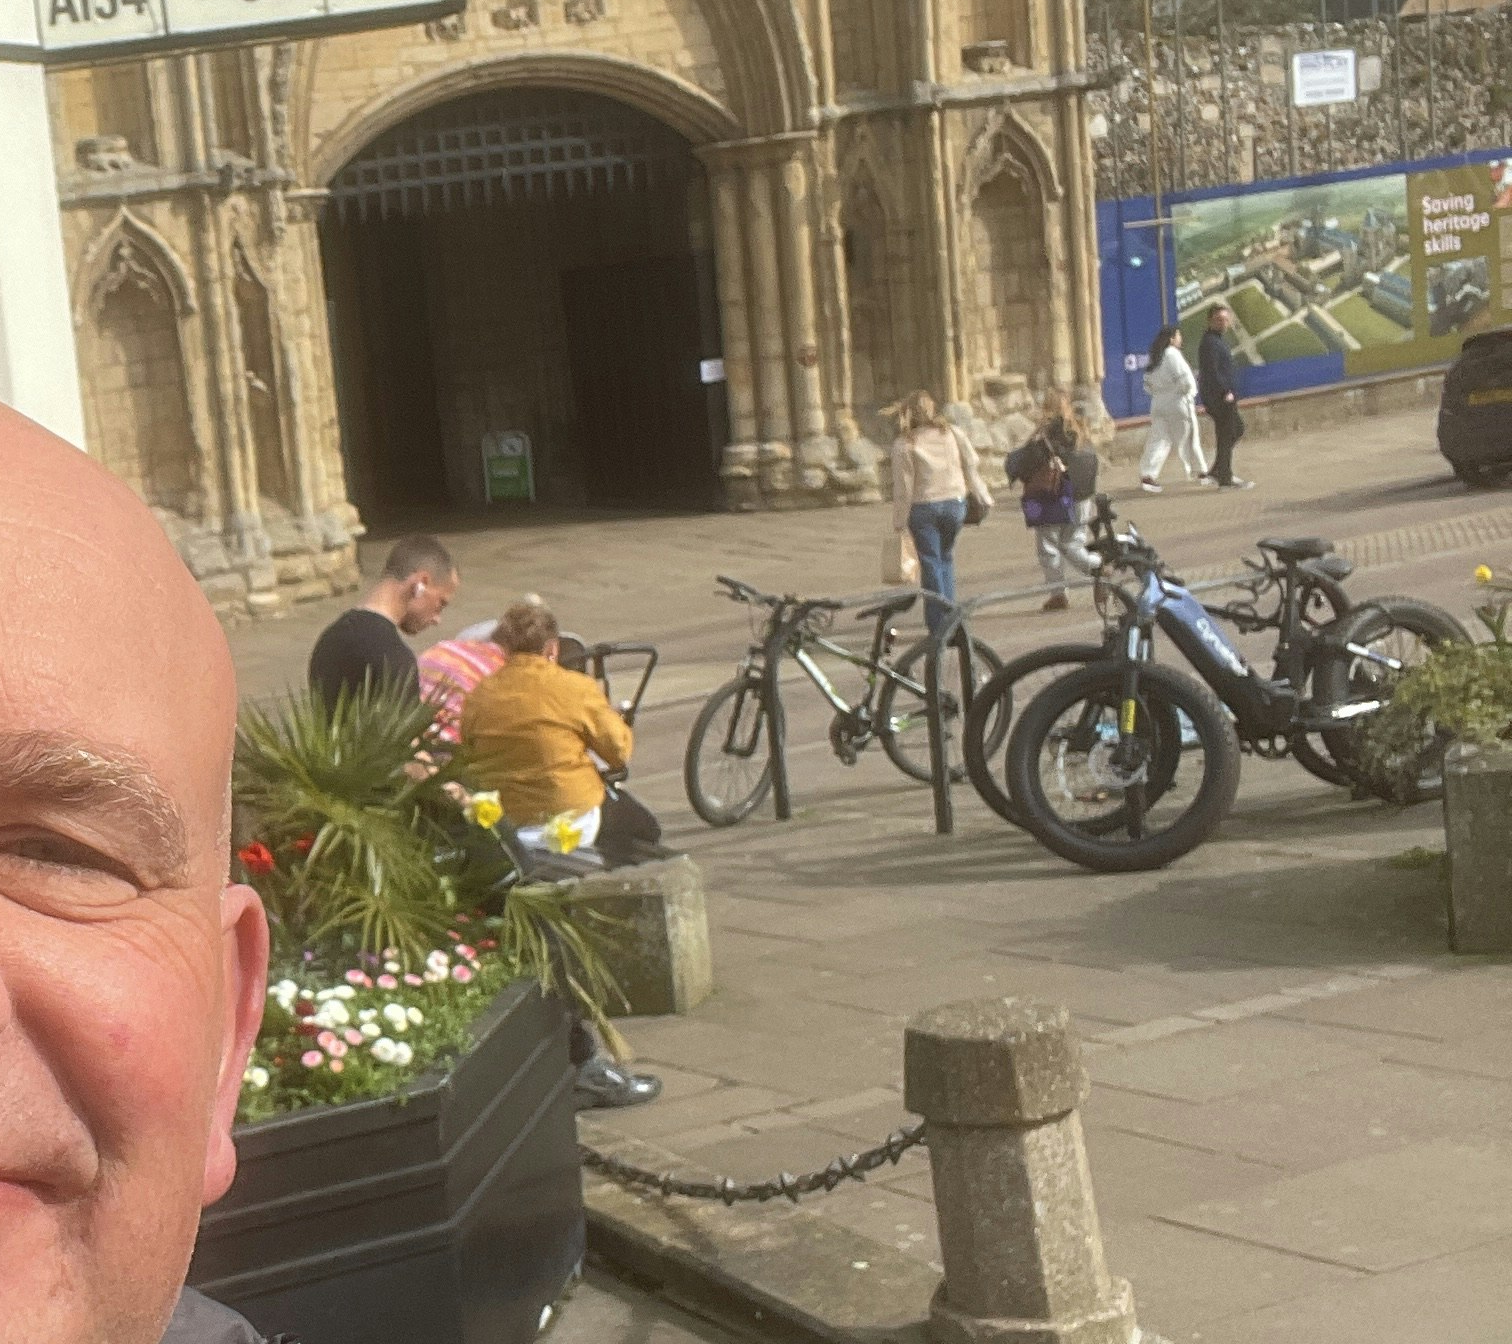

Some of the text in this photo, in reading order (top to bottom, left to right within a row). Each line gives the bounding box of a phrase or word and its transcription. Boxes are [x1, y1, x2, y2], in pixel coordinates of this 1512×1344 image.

[1422, 193, 1474, 215] Saving
[1423, 212, 1490, 235] heritage
[1424, 234, 1462, 256] skills
